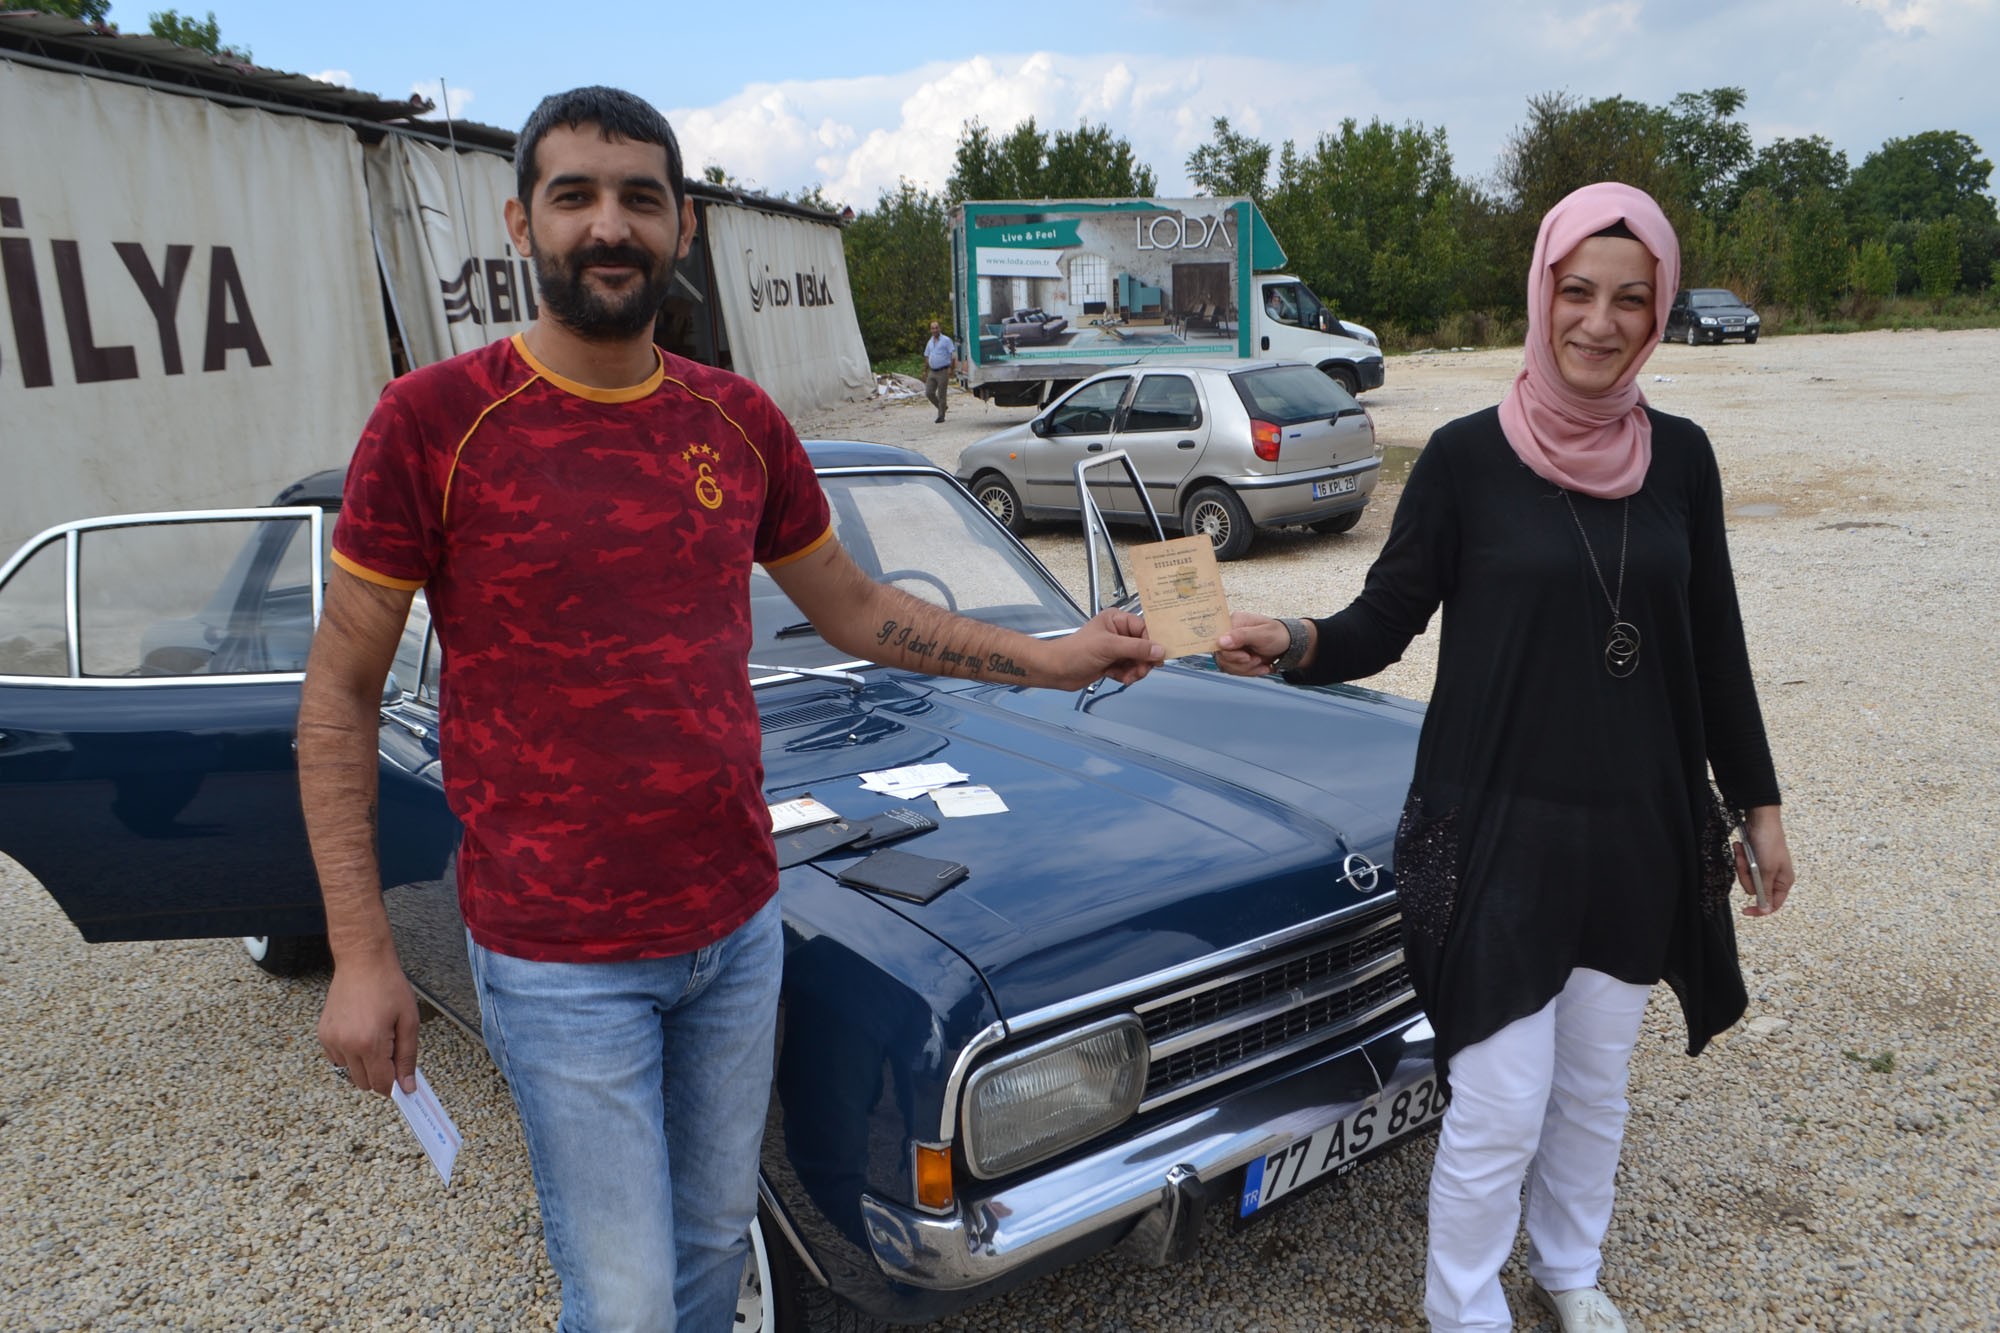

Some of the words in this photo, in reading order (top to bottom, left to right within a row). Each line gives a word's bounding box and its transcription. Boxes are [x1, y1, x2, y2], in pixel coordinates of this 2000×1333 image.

[1002, 233, 1023, 243] Live
[1025, 231, 1032, 240] &
[1036, 229, 1056, 240] Feel
[1137, 216, 1232, 250] LODA
[986, 257, 1050, 266] www.loda.com.tr
[1318, 484, 1327, 496] 16
[1329, 480, 1342, 493] KPL
[1345, 478, 1354, 490] 25
[877, 620, 897, 645] If
[1264, 1136, 1313, 1201] 77
[1321, 1106, 1377, 1170] AS
[1337, 1161, 1358, 1176] 1971
[1244, 1190, 1260, 1207] TR
